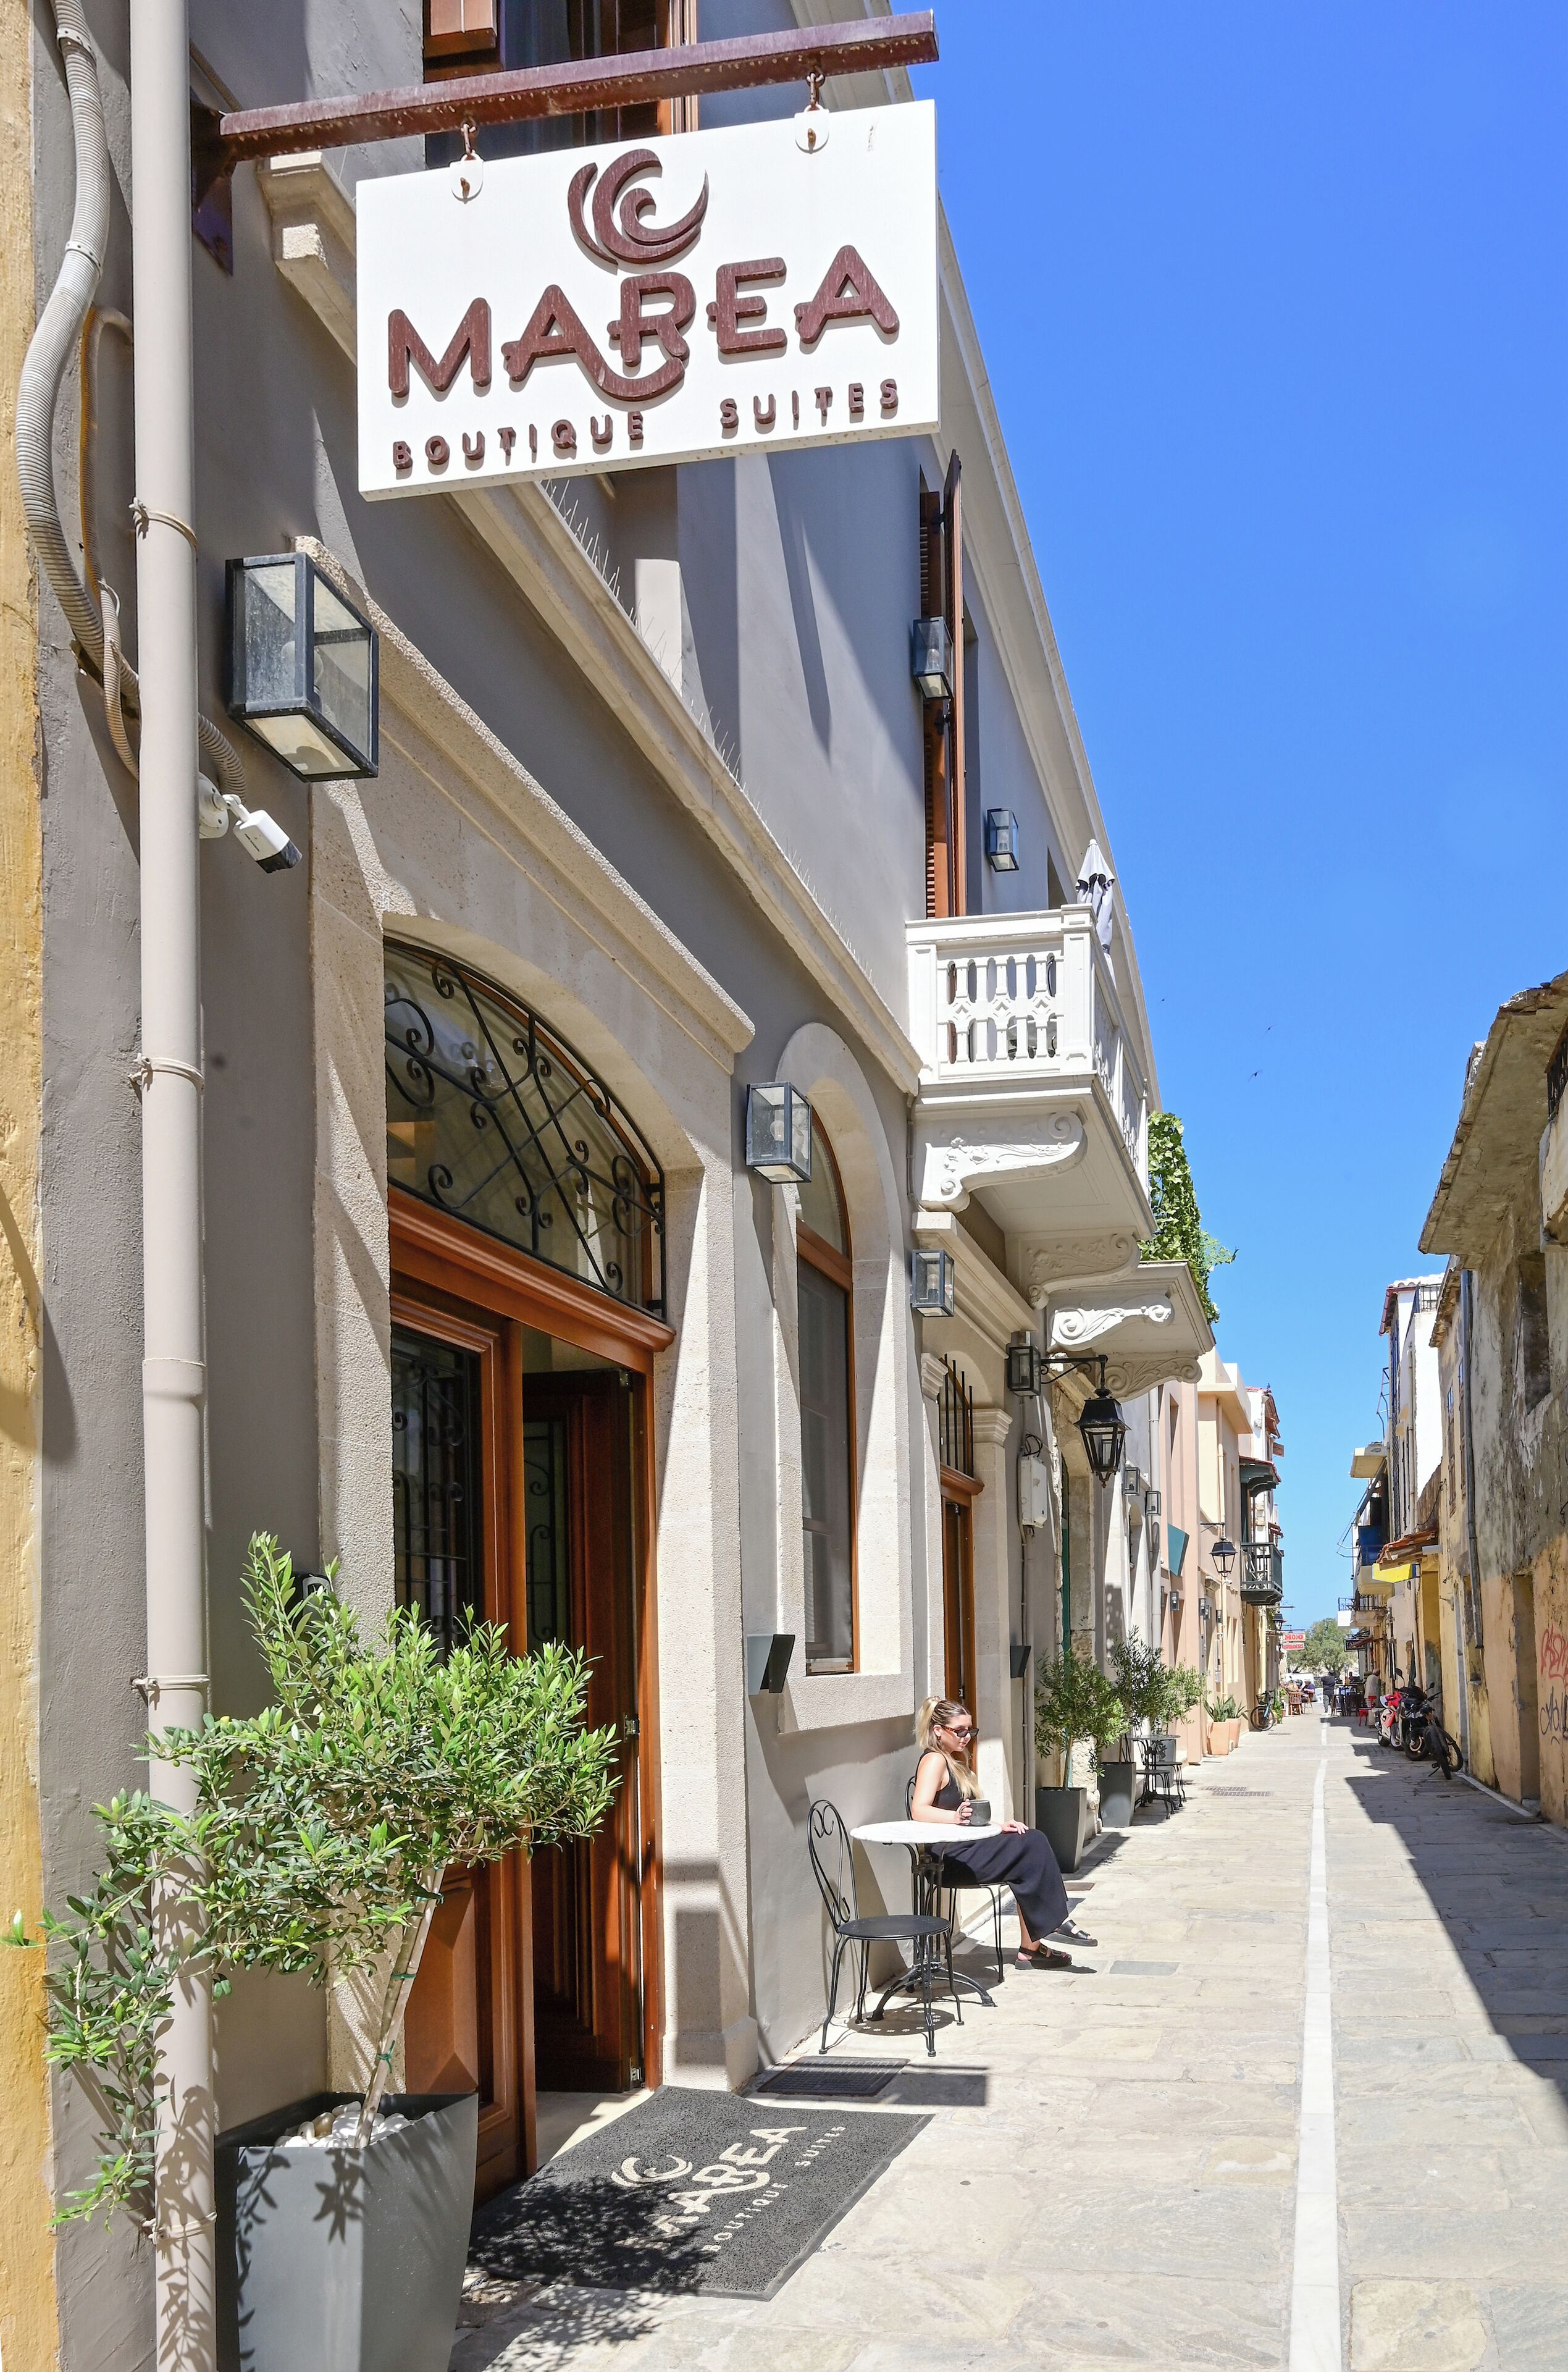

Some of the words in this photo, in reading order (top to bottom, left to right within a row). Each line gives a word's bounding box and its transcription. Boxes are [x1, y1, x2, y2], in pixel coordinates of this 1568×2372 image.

[387, 245, 900, 402] MAREA
[392, 410, 645, 470] BOUTIQUE
[719, 378, 899, 429] SUITES
[614, 2126, 807, 2251] MAREA
[701, 2182, 789, 2252] BOUTIQUE
[794, 2126, 847, 2167] SUITES
